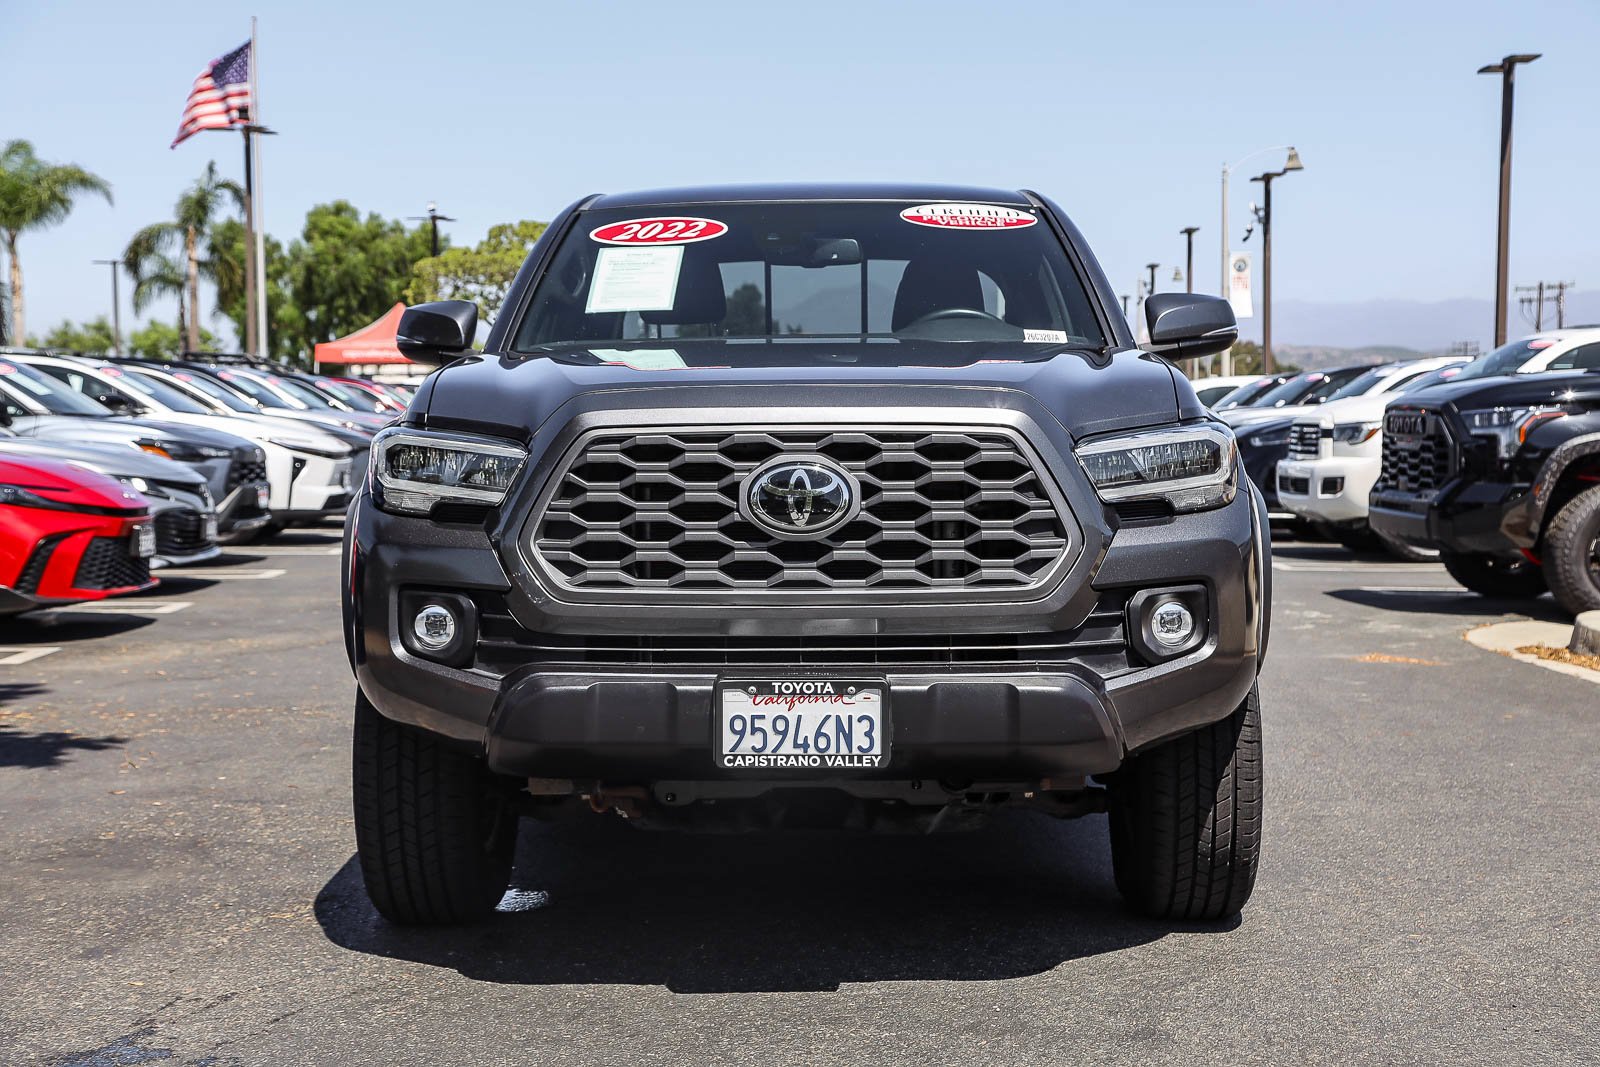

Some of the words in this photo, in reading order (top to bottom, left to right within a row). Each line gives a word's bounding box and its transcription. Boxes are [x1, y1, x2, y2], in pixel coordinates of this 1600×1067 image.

[612, 221, 707, 241] 2022
[1389, 416, 1423, 434] TOYOTA
[772, 682, 834, 694] TOYOTA
[752, 694, 856, 712] California
[728, 714, 875, 754] 95946N3
[723, 755, 821, 767] CAPISTRANO
[825, 755, 882, 767] VALLEY
